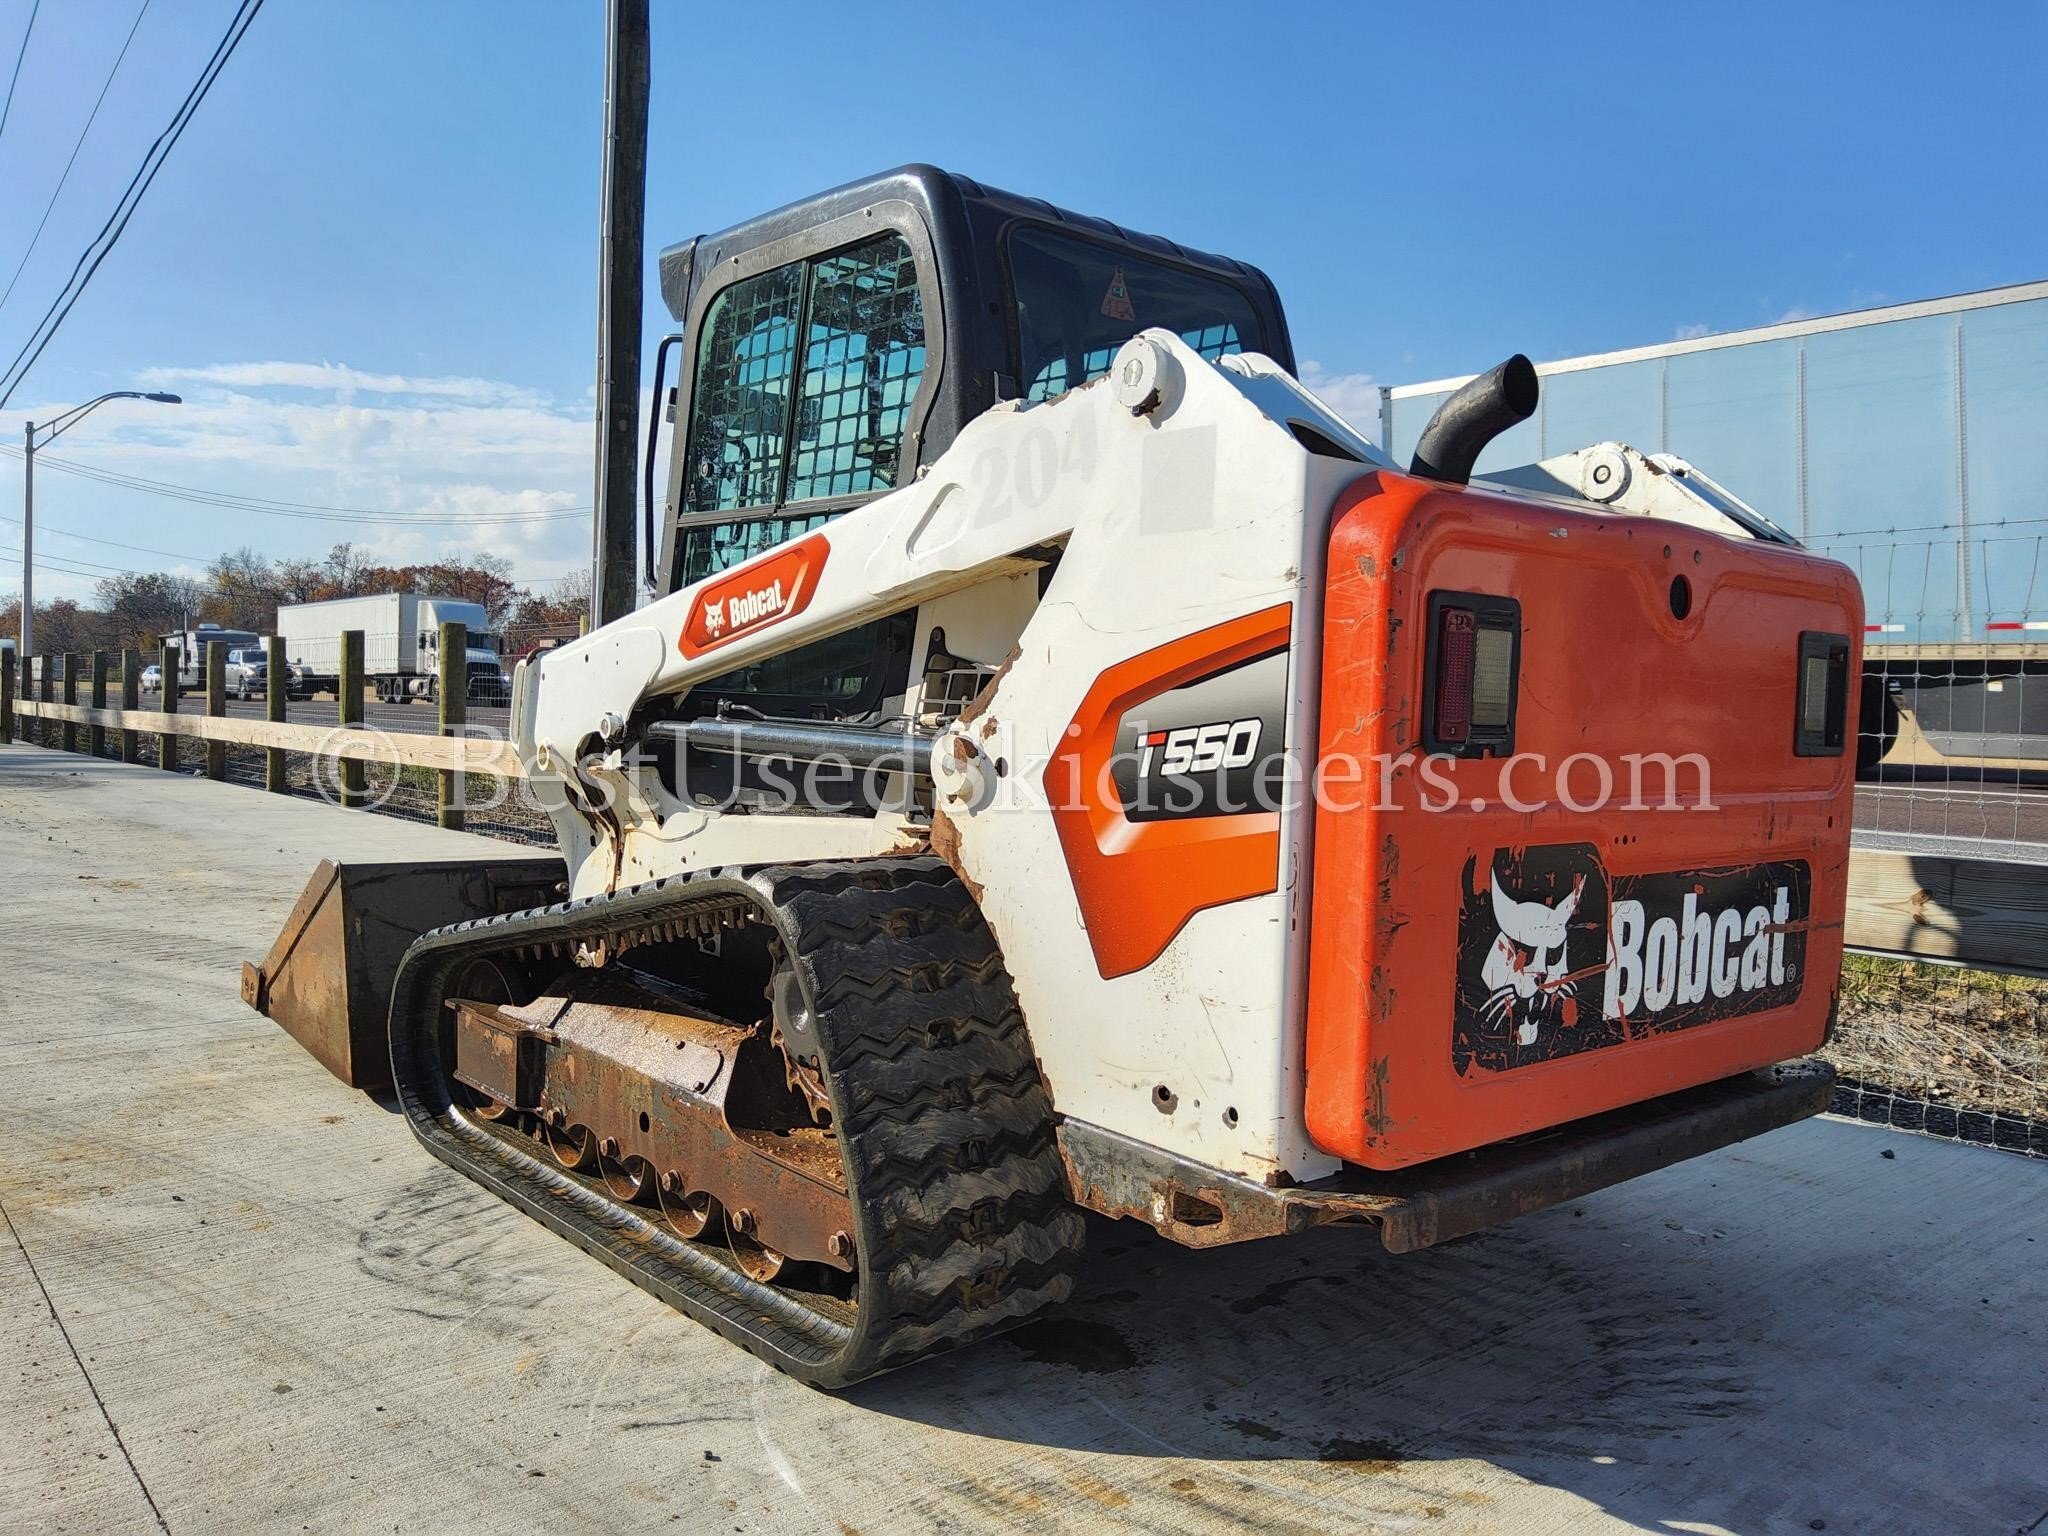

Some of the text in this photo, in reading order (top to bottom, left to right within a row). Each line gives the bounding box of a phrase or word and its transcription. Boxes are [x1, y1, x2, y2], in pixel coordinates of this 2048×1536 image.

[728, 578, 783, 629] Bobcat
[1137, 717, 1262, 778] T550
[1602, 886, 1791, 1021] Bobcat
